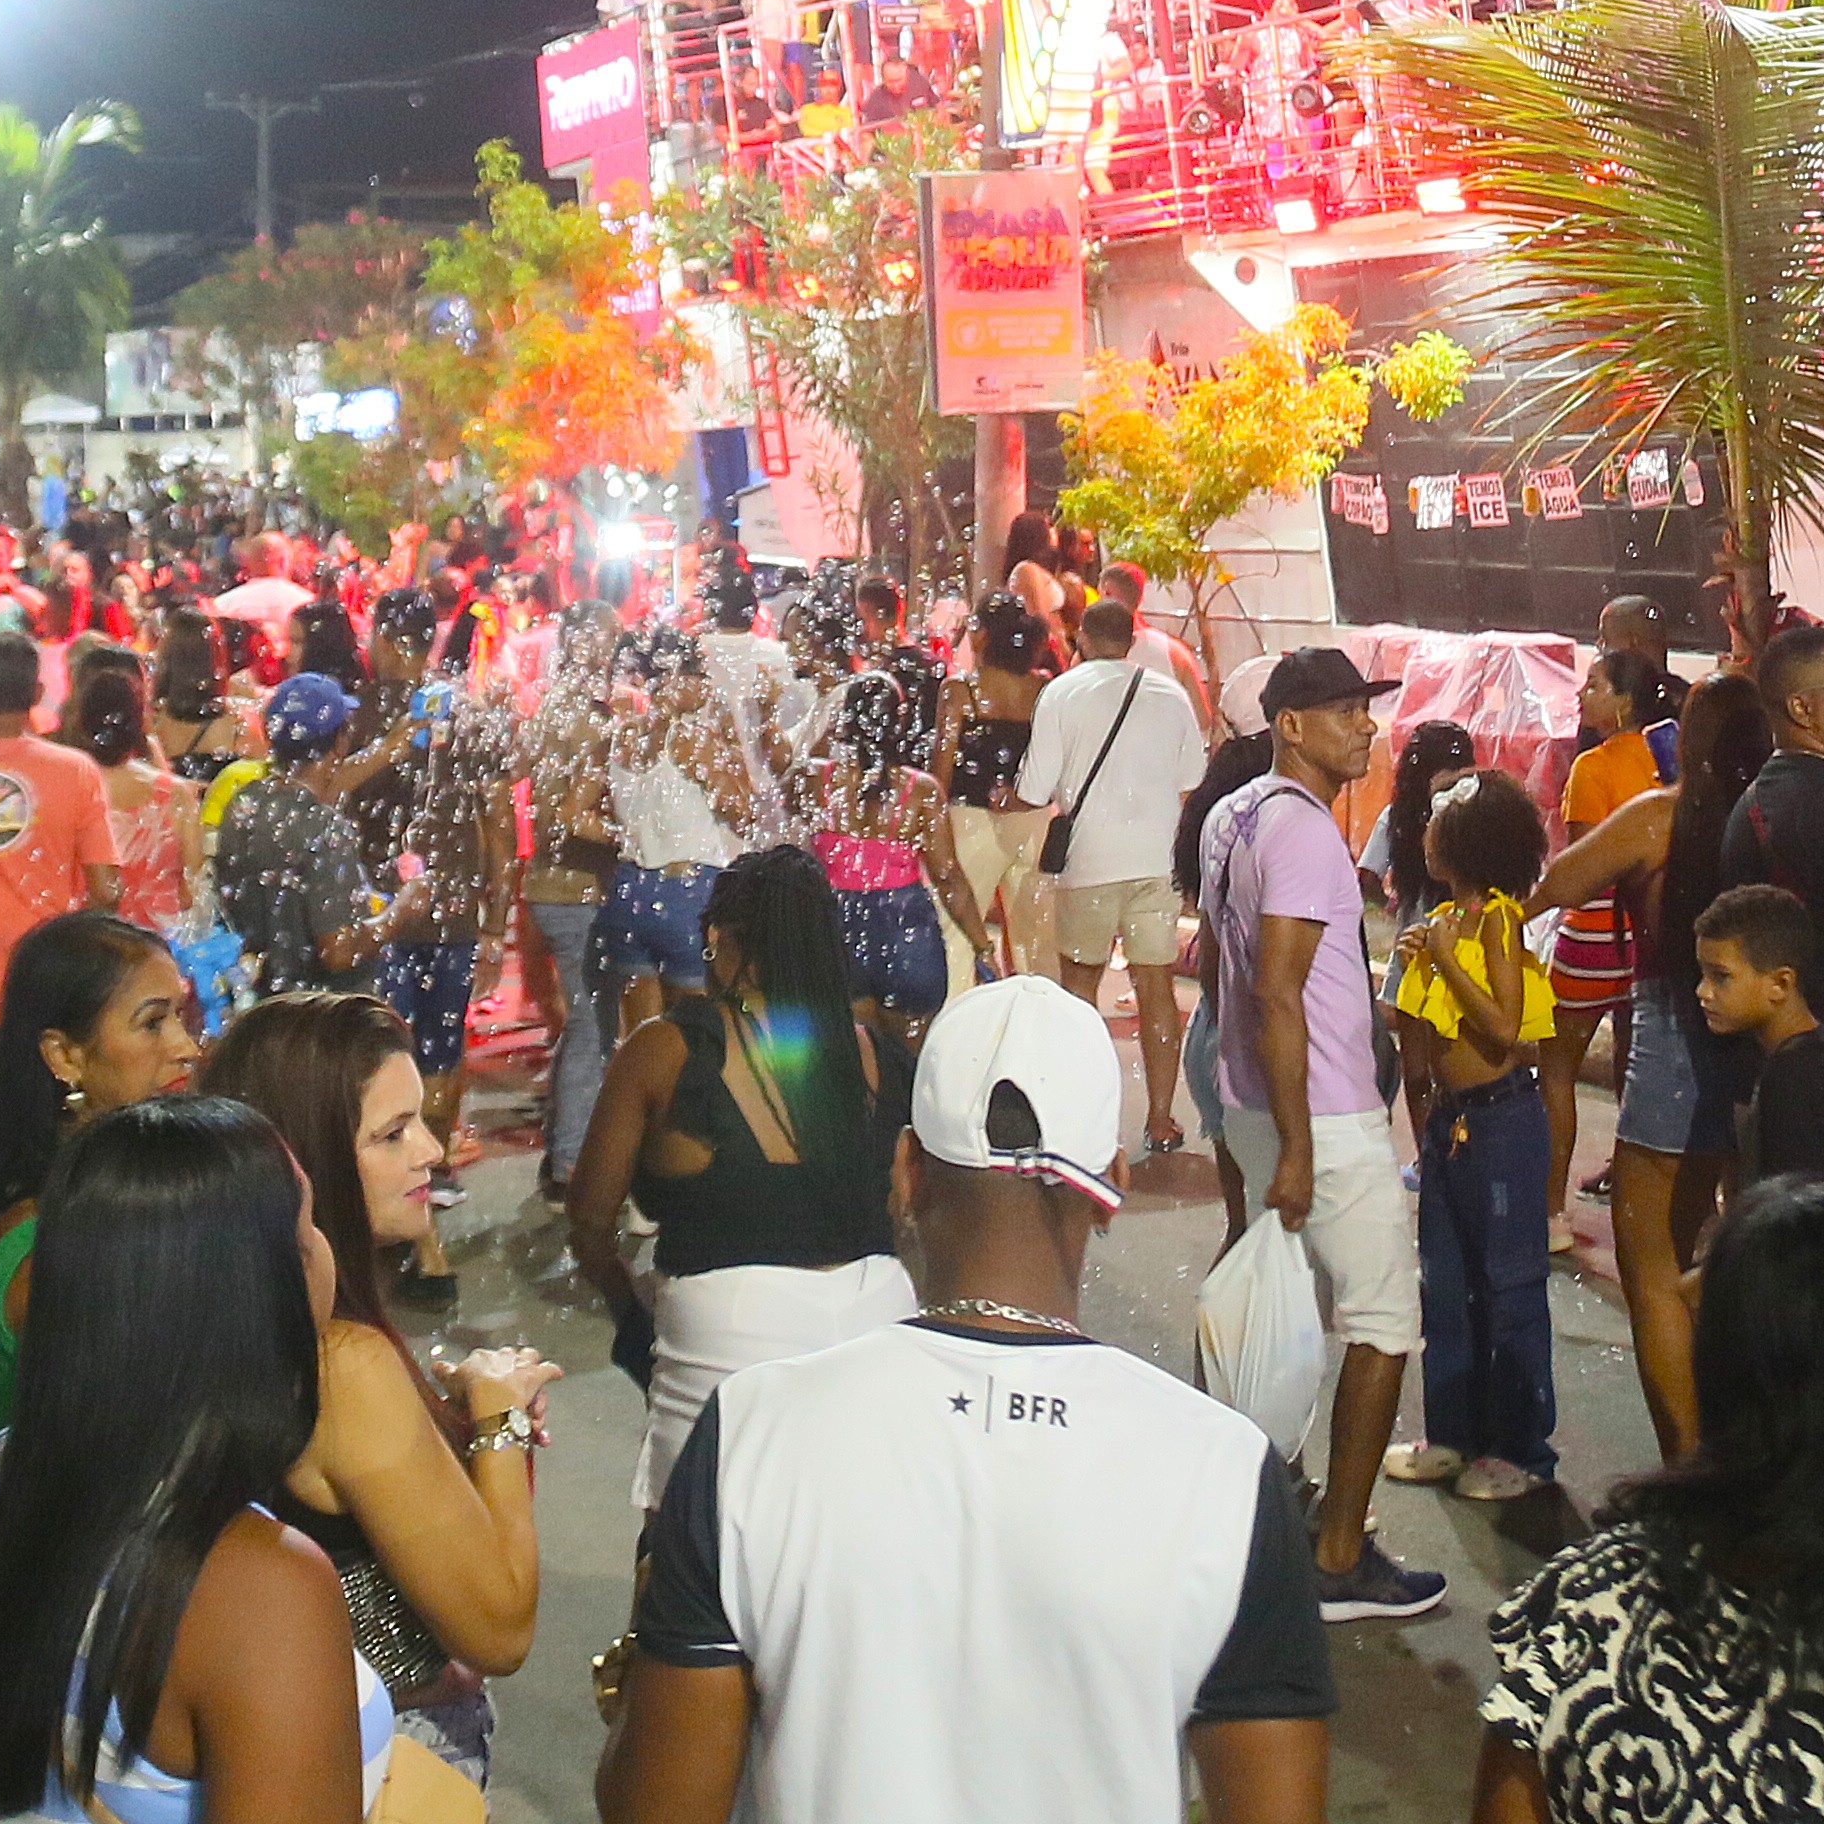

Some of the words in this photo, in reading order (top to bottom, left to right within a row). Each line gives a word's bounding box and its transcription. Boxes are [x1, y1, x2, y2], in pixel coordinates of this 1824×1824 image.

[1467, 479, 1502, 497] TEMOS
[1472, 501, 1505, 521] ICE
[1008, 1391, 1068, 1429] BFR
